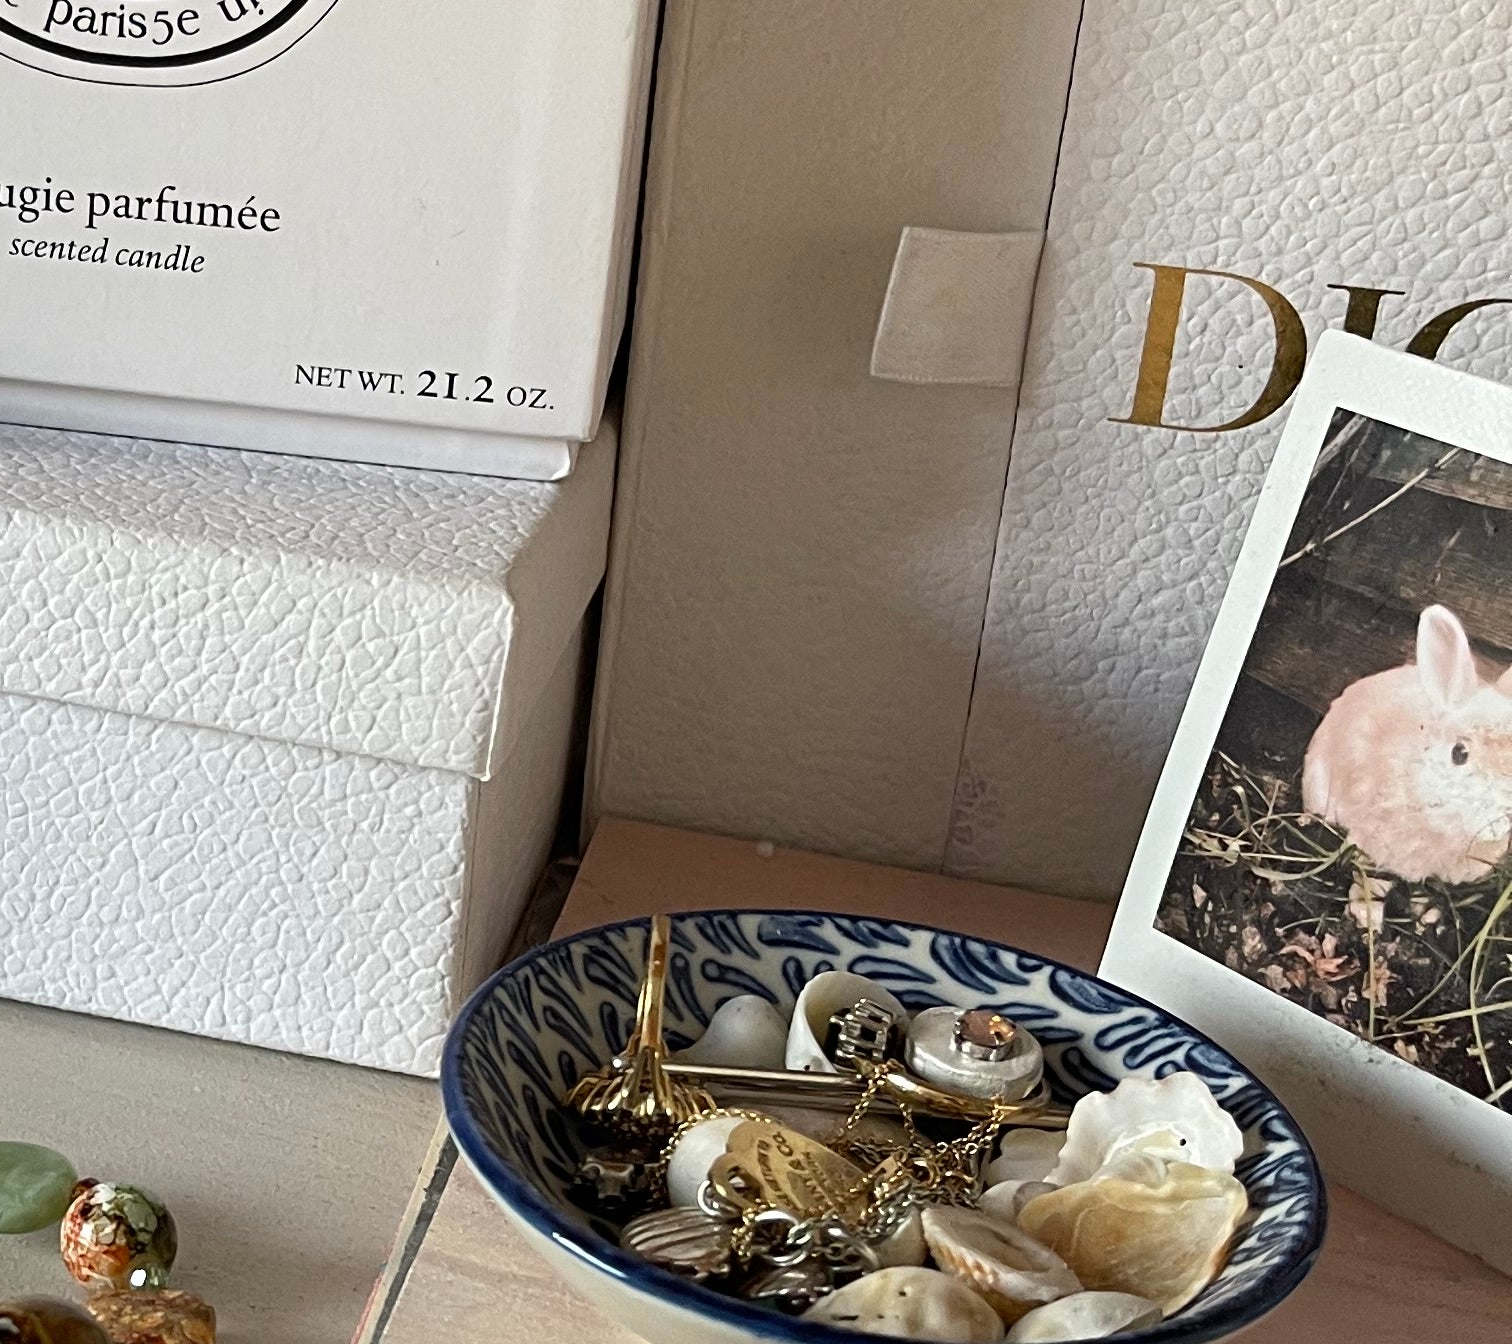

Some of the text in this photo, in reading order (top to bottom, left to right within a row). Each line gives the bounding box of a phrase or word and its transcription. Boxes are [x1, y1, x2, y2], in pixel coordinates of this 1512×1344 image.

[84, 185, 281, 233] parfumée
[8, 237, 205, 274] scented candle
[294, 363, 353, 389] NET
[357, 370, 405, 395] WT.
[416, 369, 495, 404] 21.2
